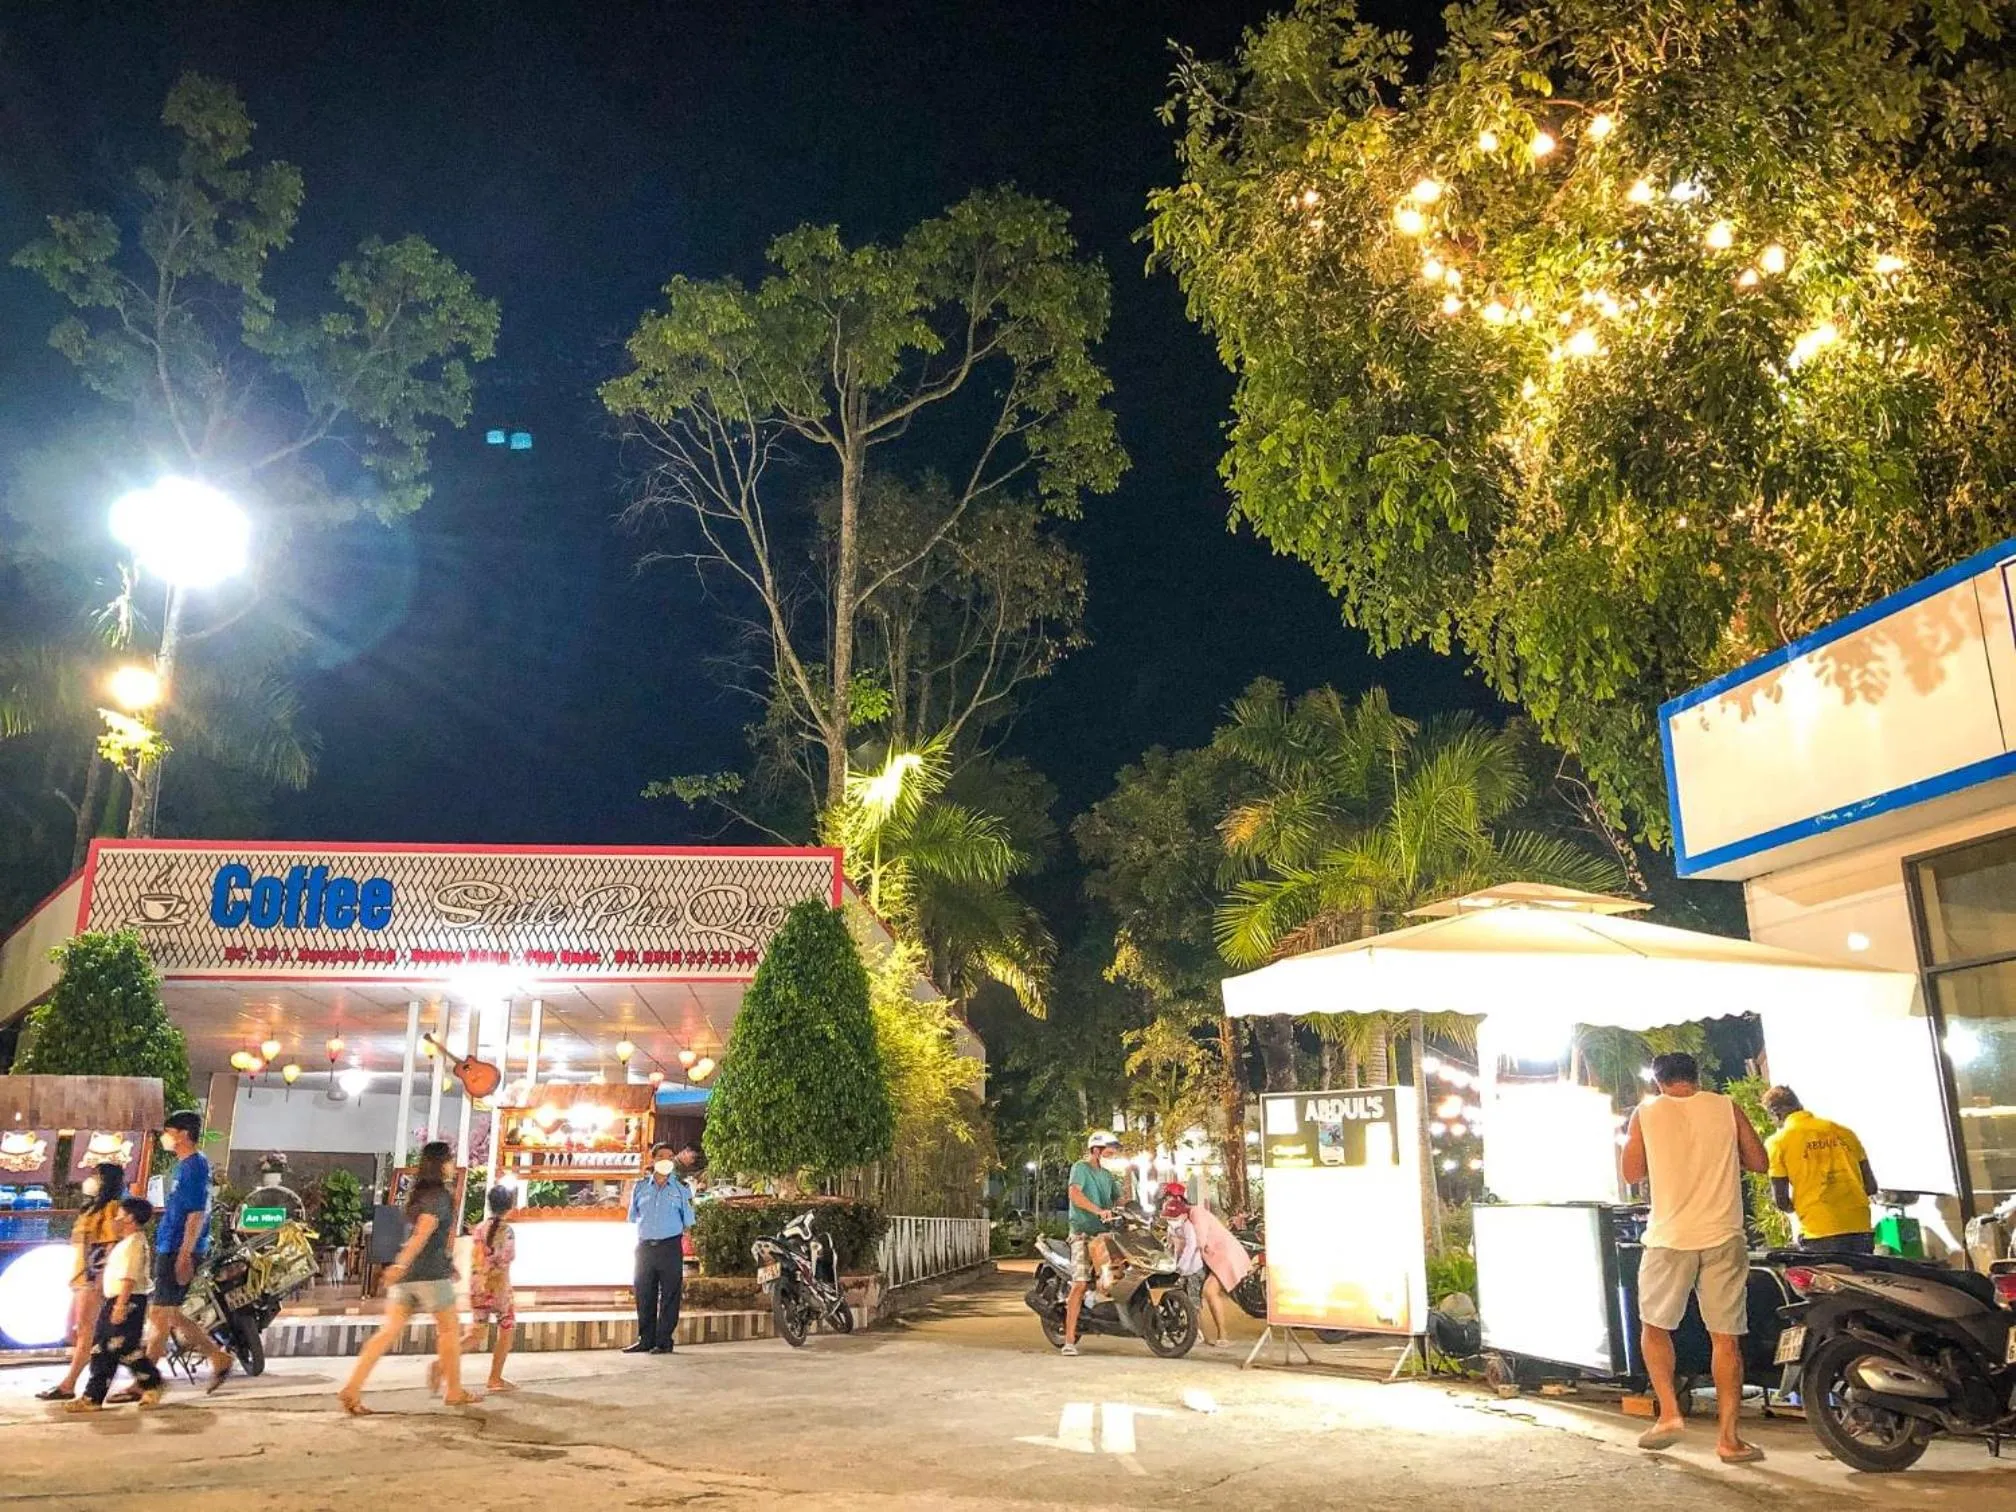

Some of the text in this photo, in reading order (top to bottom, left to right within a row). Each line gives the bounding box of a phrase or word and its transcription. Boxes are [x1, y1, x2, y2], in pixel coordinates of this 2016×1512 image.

[210, 863, 394, 931] Coffee
[434, 879, 790, 948] Smile Phu Quo
